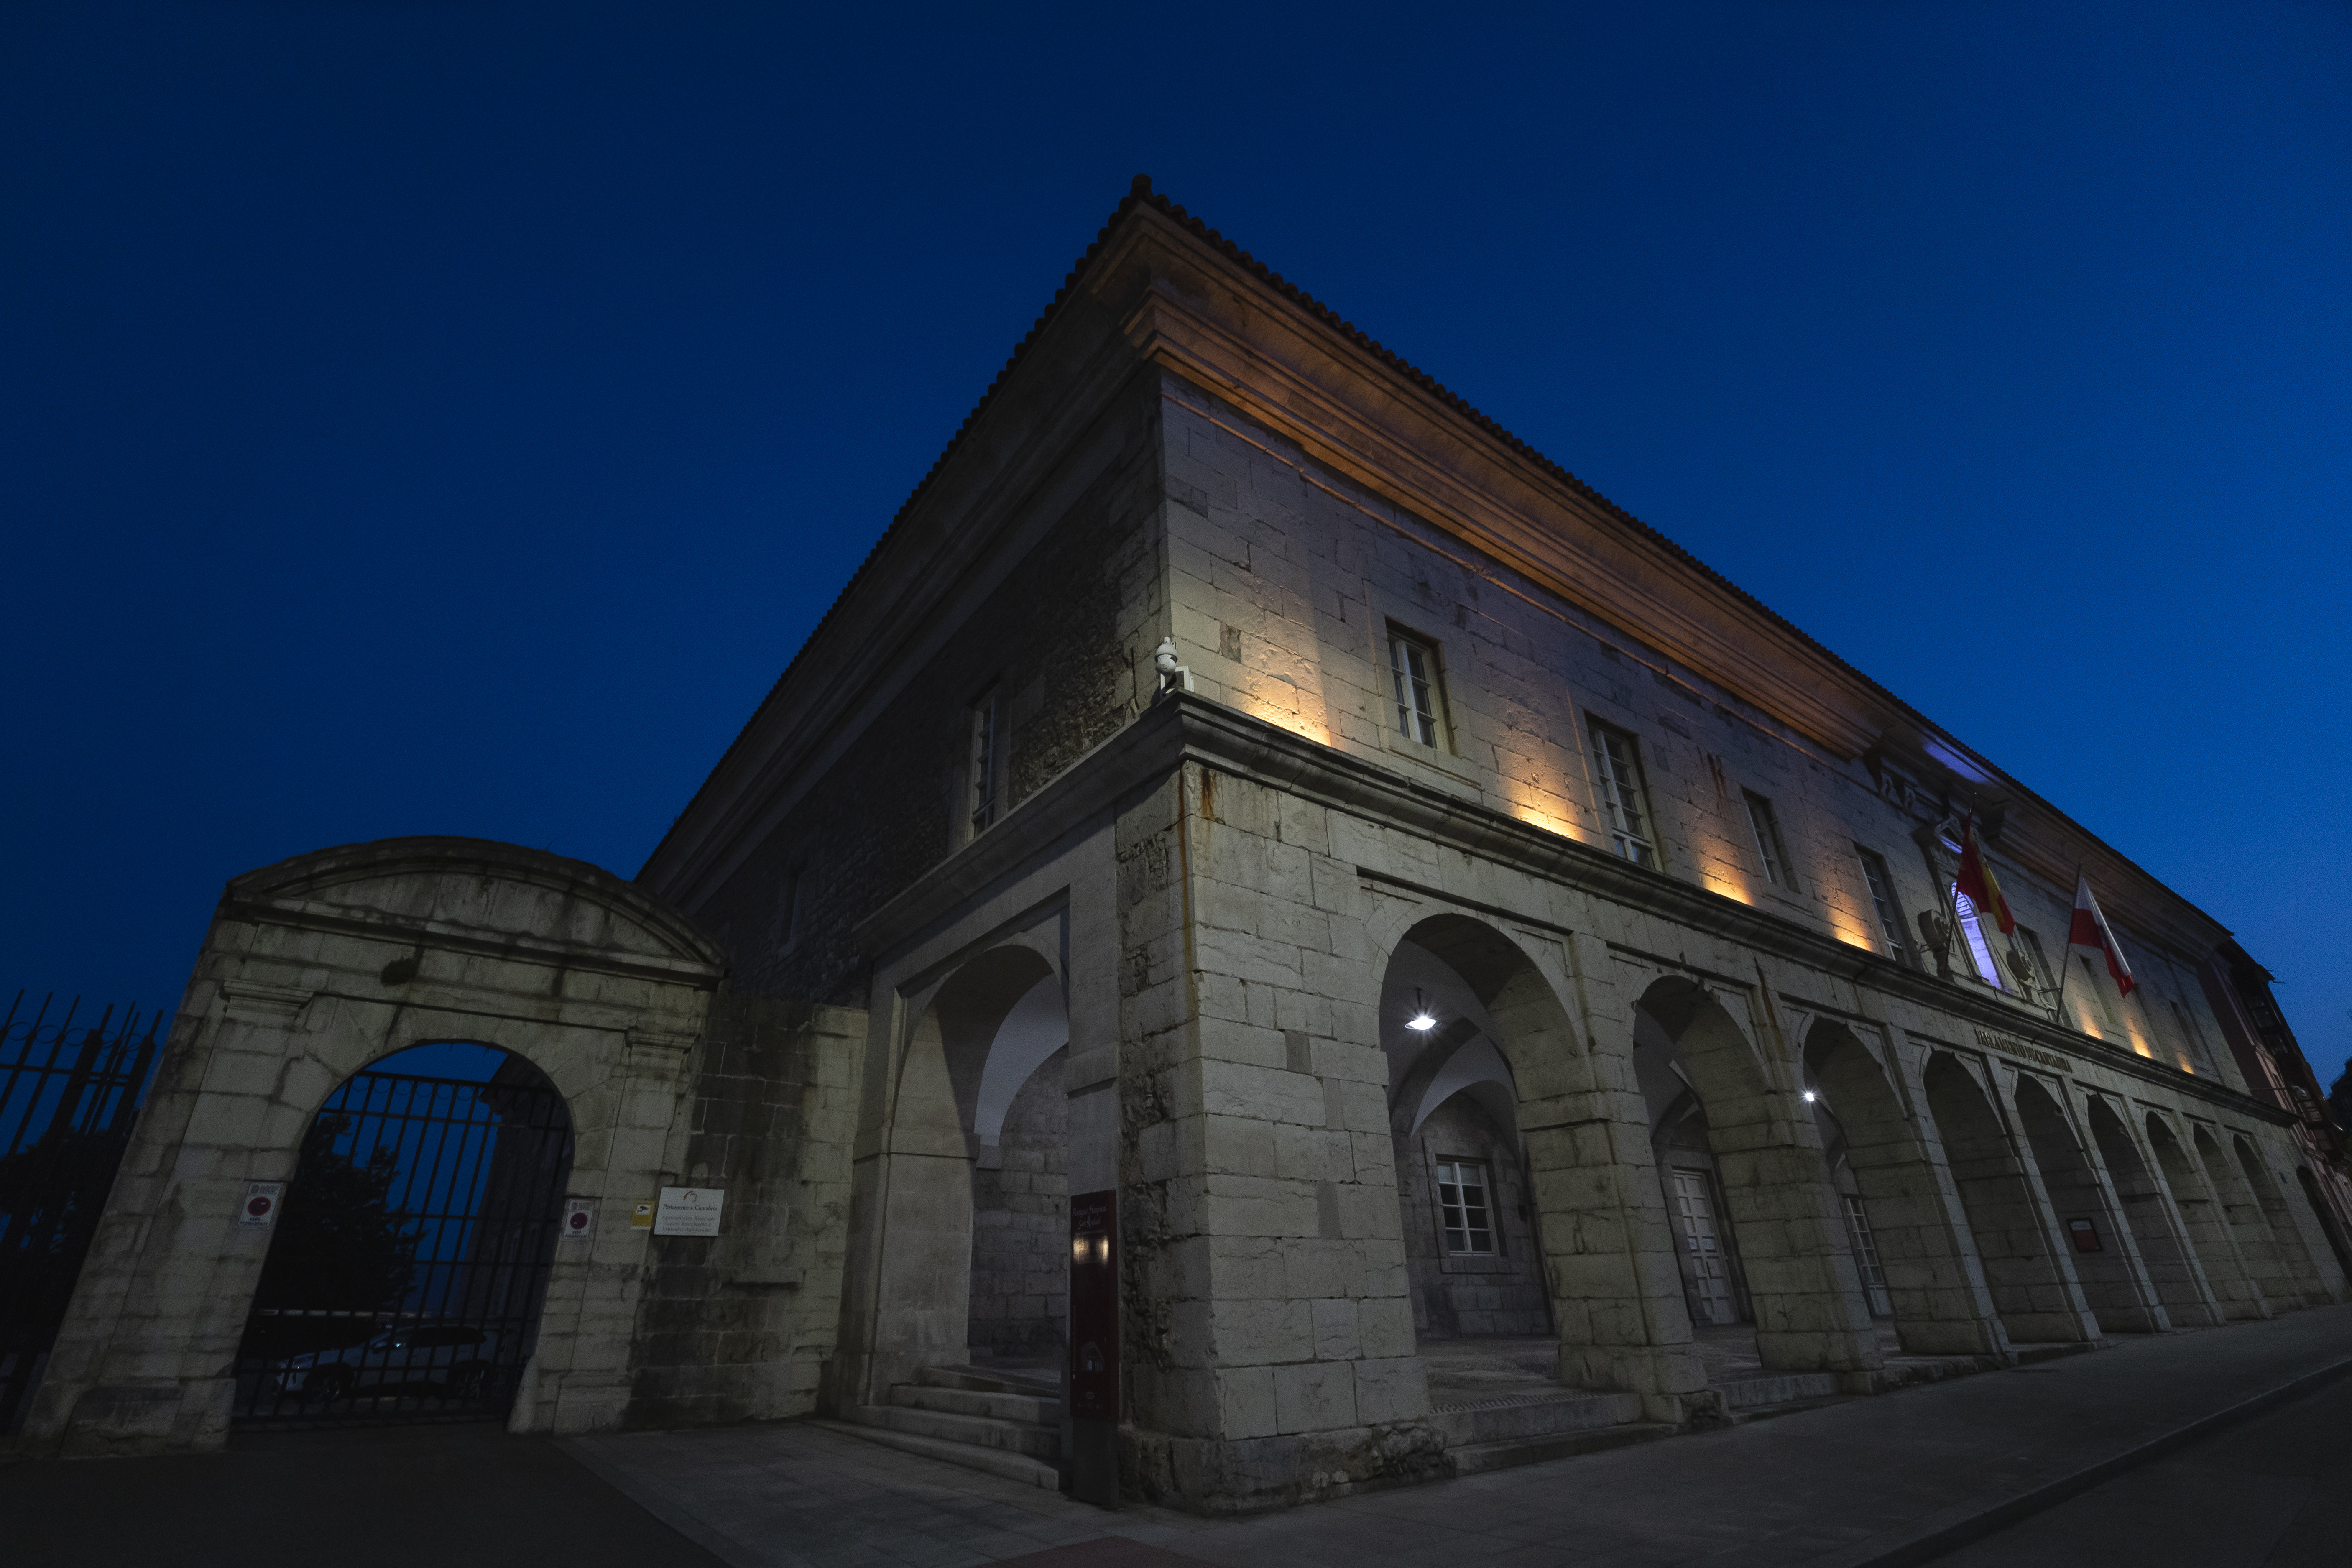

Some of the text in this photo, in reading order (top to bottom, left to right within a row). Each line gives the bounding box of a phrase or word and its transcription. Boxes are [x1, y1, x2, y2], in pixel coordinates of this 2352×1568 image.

[1975, 1029, 2026, 1058] PARLAMENTO
[2035, 1049, 2073, 1073] CANTABRIA
[1088, 1203, 1107, 1216] Hospital
